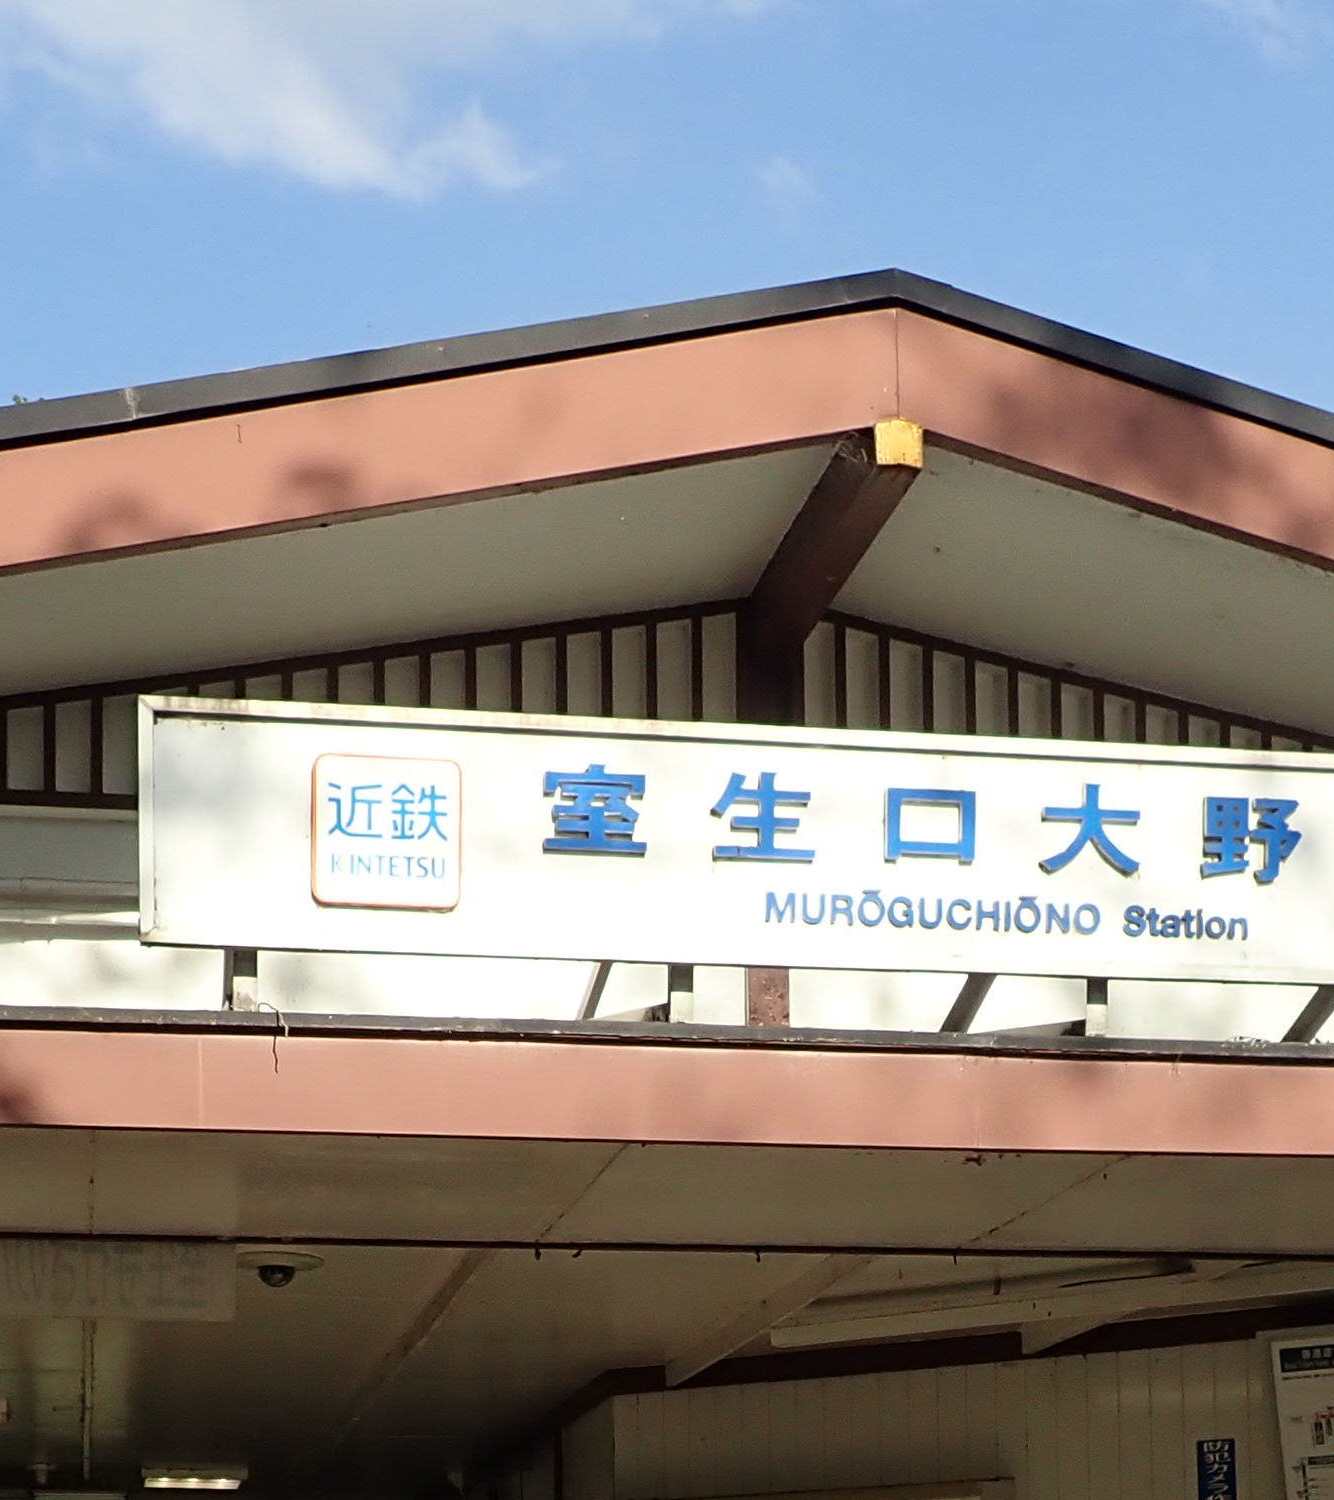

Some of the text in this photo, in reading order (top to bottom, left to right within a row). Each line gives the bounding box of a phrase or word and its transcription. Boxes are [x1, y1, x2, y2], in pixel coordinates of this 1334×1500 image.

[327, 782, 449, 841] 近鉄
[330, 853, 446, 878] KINTETSU
[764, 889, 1249, 941] MURŌGUCHIŌNO Station
